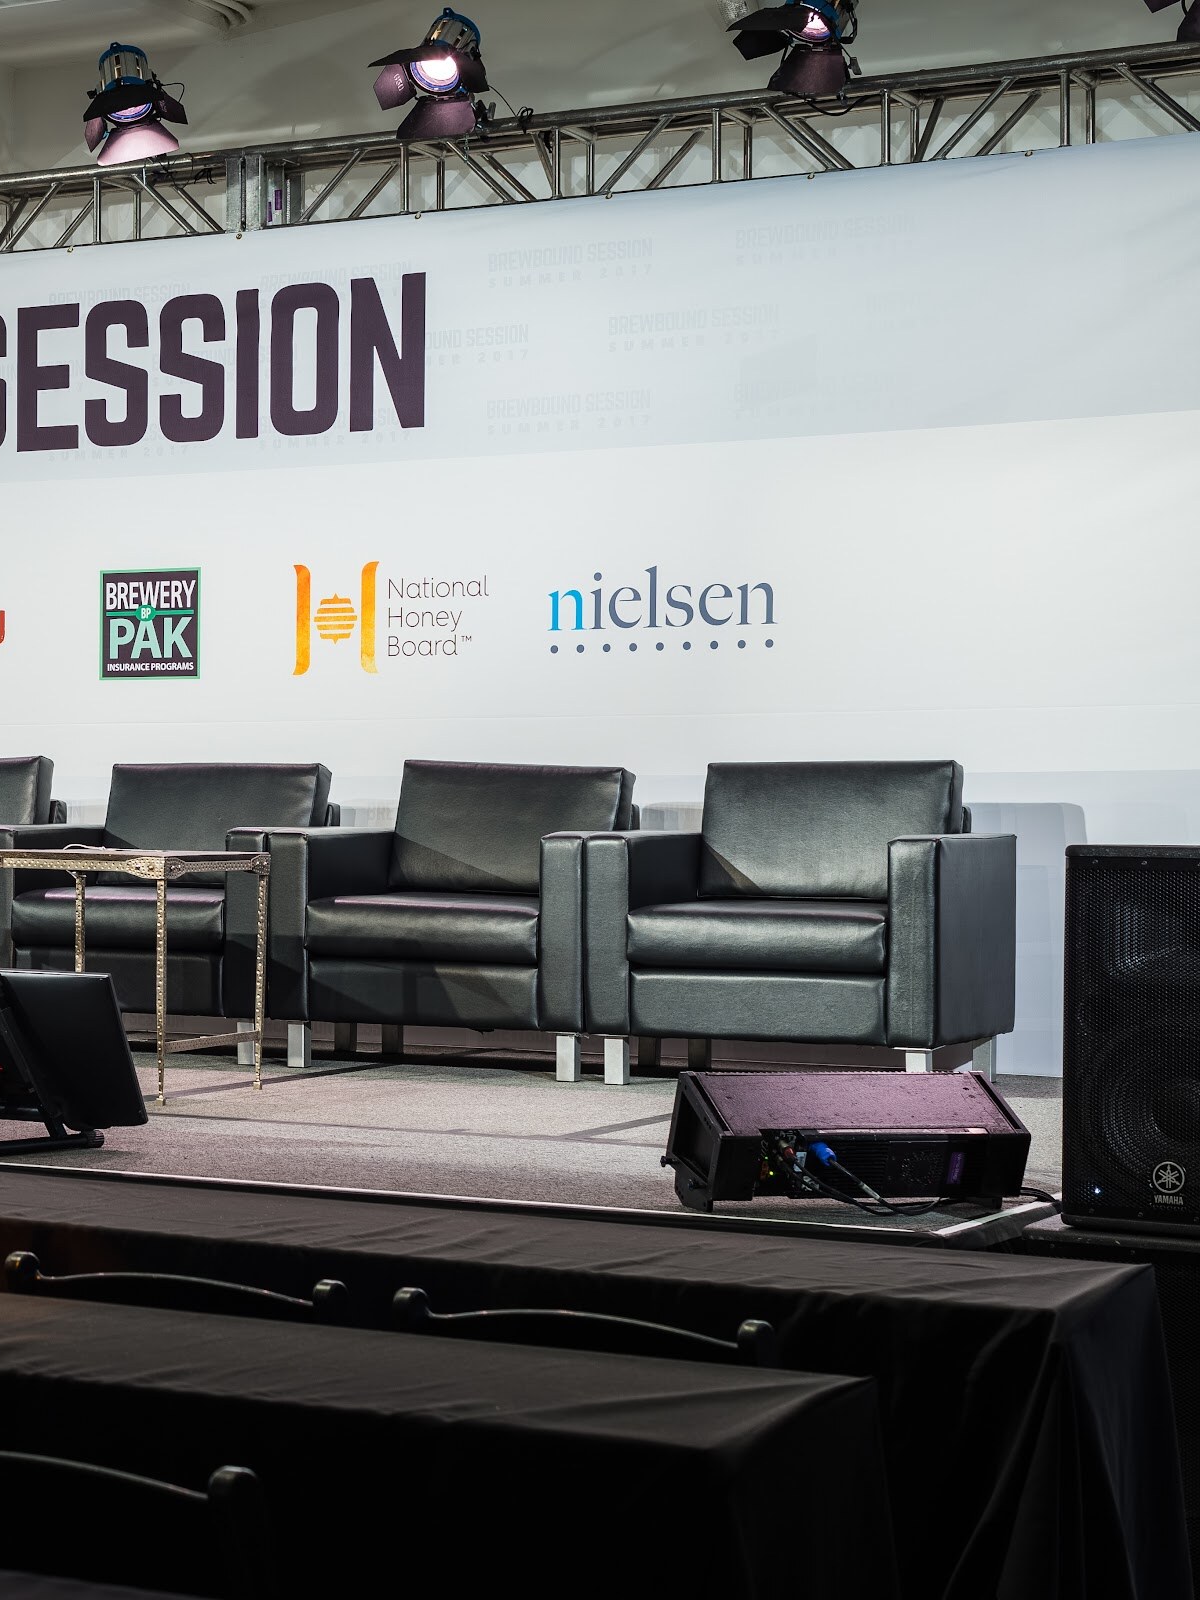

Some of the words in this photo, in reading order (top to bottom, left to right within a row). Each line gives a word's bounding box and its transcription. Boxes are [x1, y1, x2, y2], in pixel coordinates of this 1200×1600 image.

[487, 245, 584, 273] BREWBOUND
[586, 236, 654, 263] SESSION
[487, 270, 583, 290] SUMMER
[599, 263, 654, 280] 2017
[608, 308, 708, 337] BREWBOUND
[710, 303, 780, 329] SESSION
[466, 323, 529, 347] SESSION
[477, 349, 529, 364] 2017
[486, 393, 583, 421] BREWBOUND
[585, 388, 652, 414] SESSION
[105, 580, 196, 610] BREWERY
[388, 575, 489, 599] National
[547, 566, 778, 631] nielsen
[140, 608, 152, 619] BP
[388, 607, 462, 632] Honey
[109, 616, 193, 660] PAK
[107, 663, 150, 672] INSURANCE
[150, 662, 194, 671] PROGRAMS
[1153, 1194, 1184, 1205] YAMAHA
